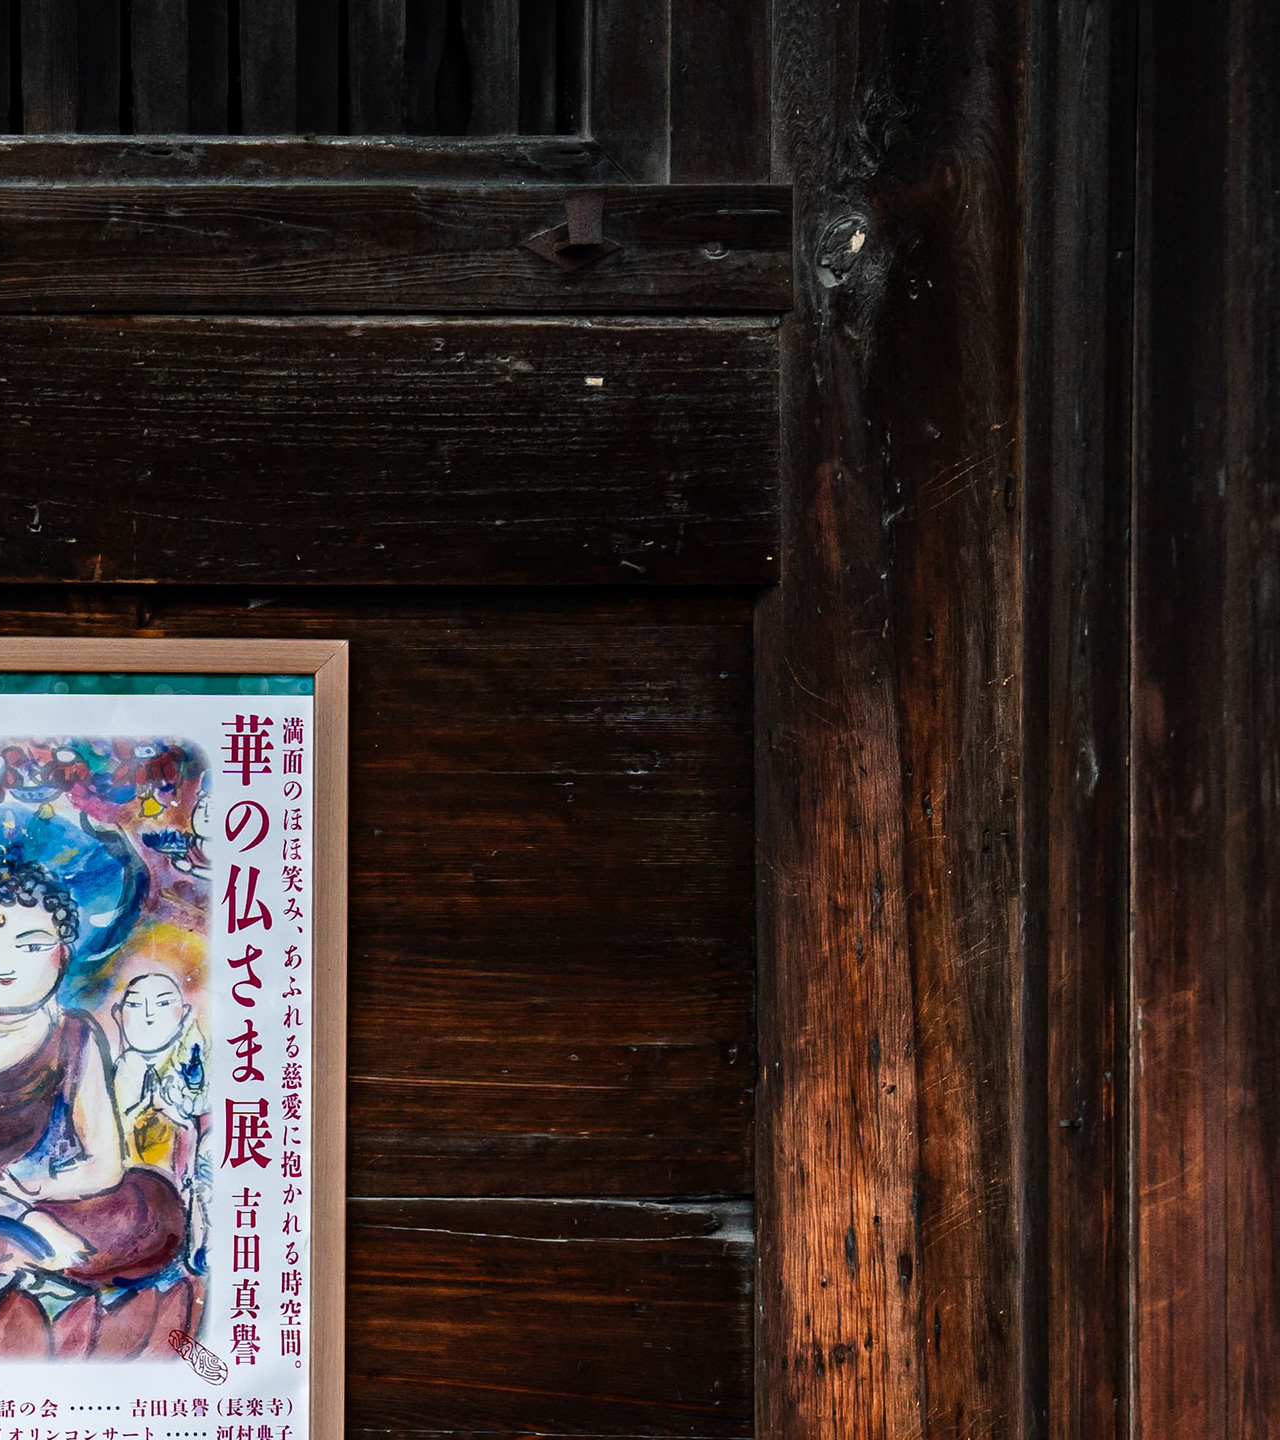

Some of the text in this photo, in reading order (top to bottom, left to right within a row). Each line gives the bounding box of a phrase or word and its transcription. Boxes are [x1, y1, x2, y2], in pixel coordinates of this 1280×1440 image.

[220, 713, 274, 1170] 華の仏さま展
